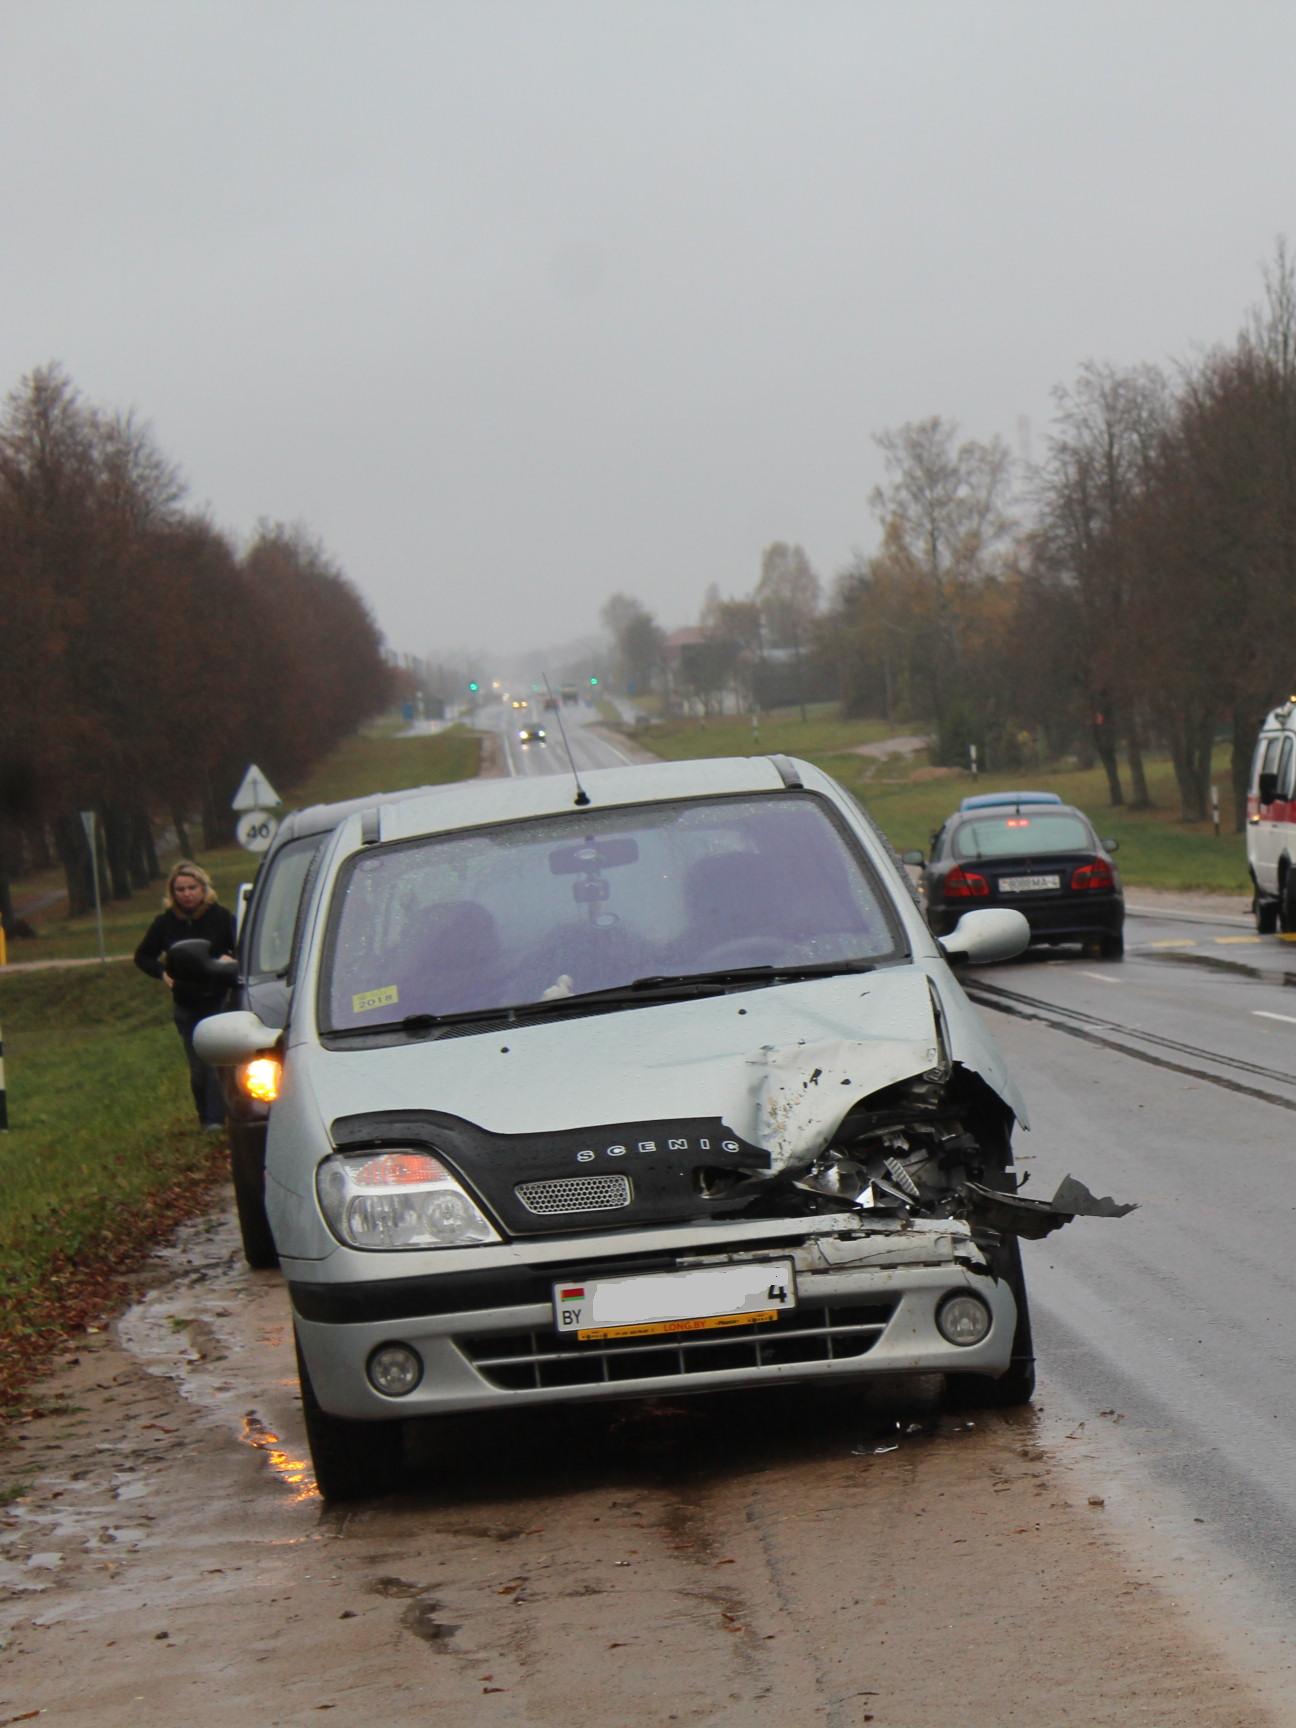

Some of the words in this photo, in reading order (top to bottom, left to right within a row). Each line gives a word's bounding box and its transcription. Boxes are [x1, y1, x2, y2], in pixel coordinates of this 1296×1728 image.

[246, 823, 270, 839] 40
[576, 1138, 740, 1163] SCENIC
[767, 1284, 787, 1304] 4
[561, 1309, 582, 1326] BY
